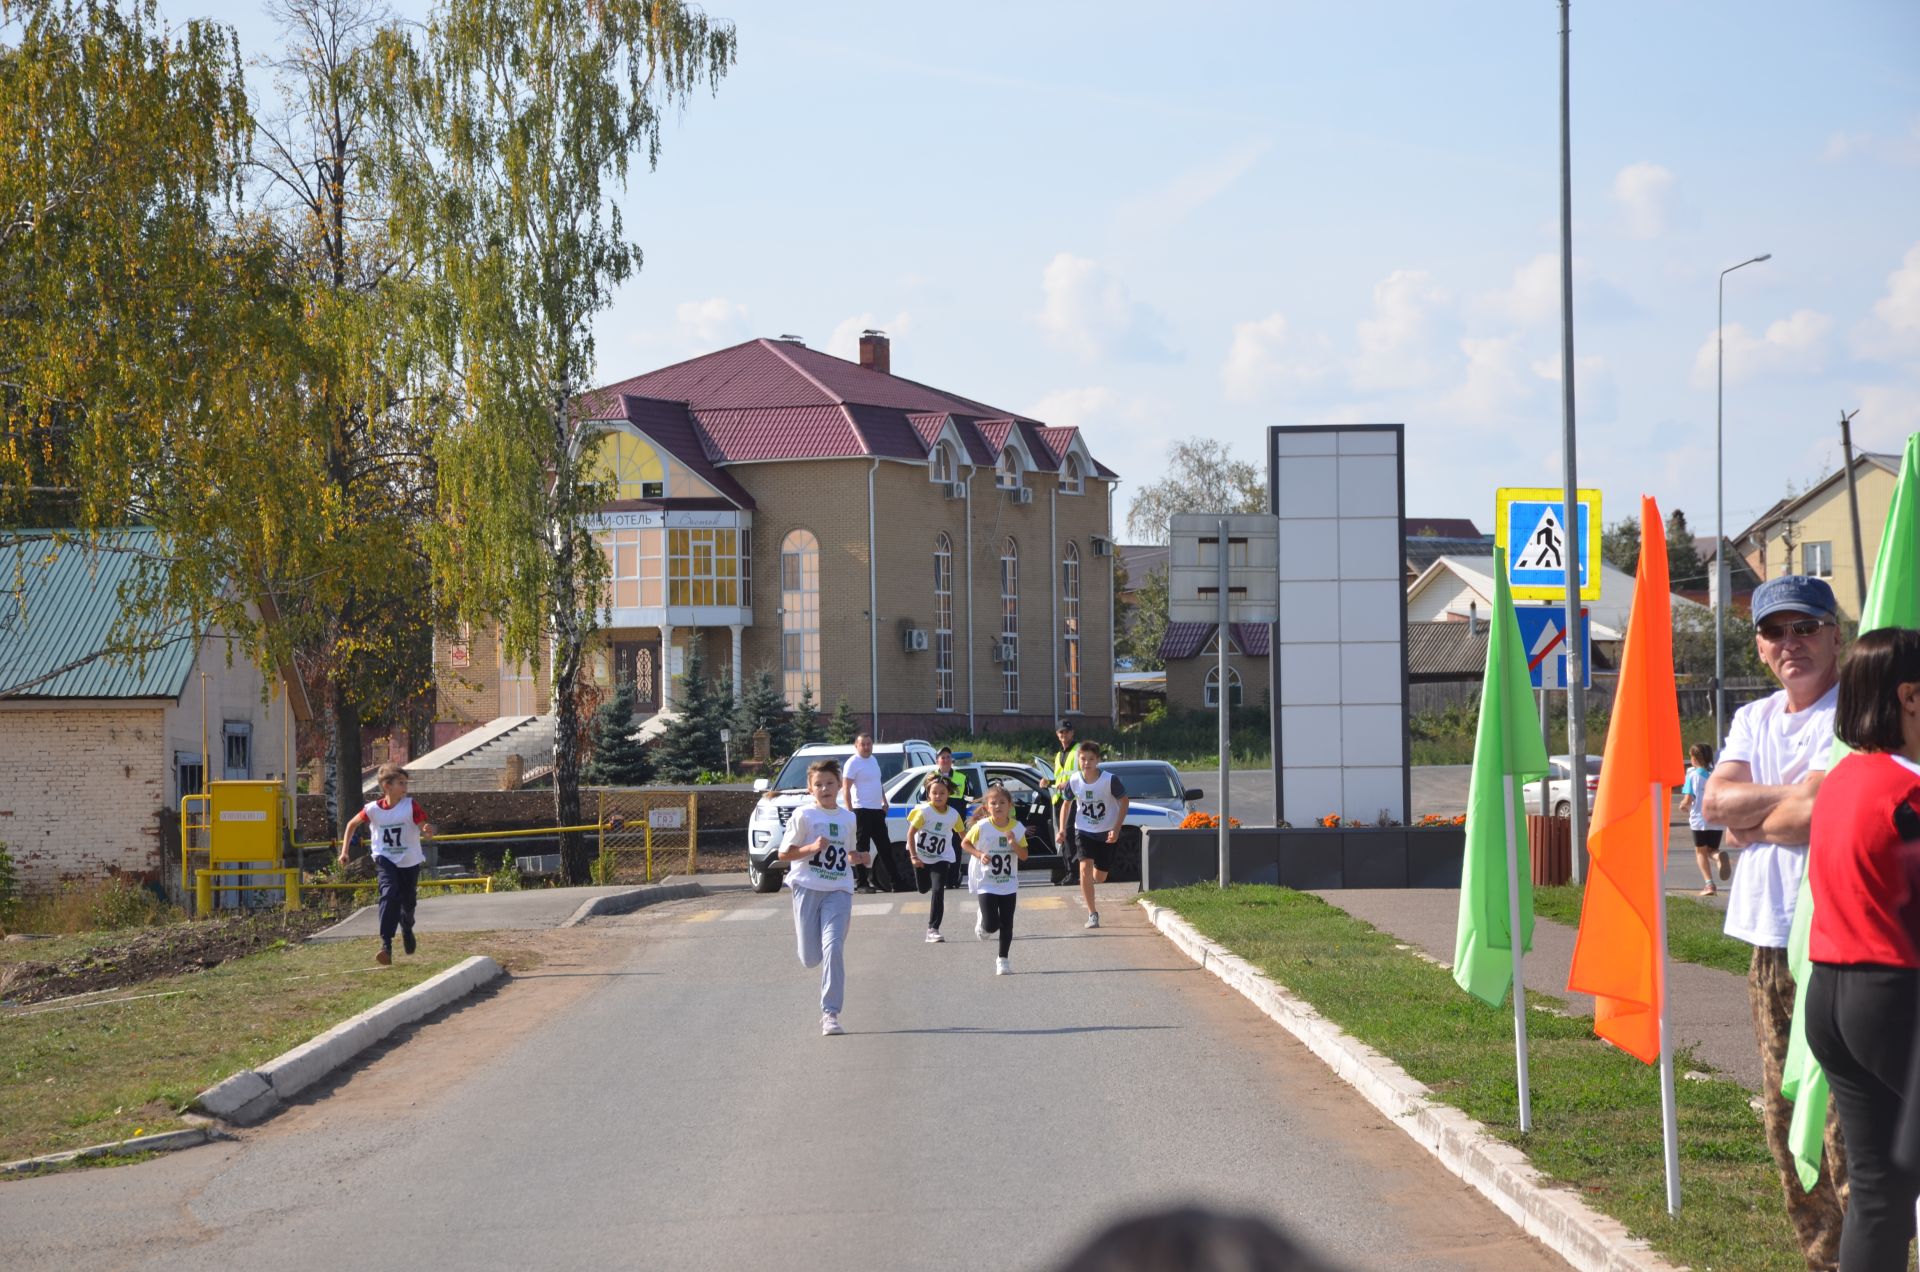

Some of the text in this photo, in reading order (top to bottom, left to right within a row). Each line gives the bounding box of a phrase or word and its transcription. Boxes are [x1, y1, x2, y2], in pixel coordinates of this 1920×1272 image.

[657, 815, 674, 823] ГАЗ
[1081, 802, 1106, 819] 212
[383, 827, 402, 847] 47
[917, 832, 946, 855] 130
[809, 845, 846, 871] 193
[991, 854, 1012, 876] 93
